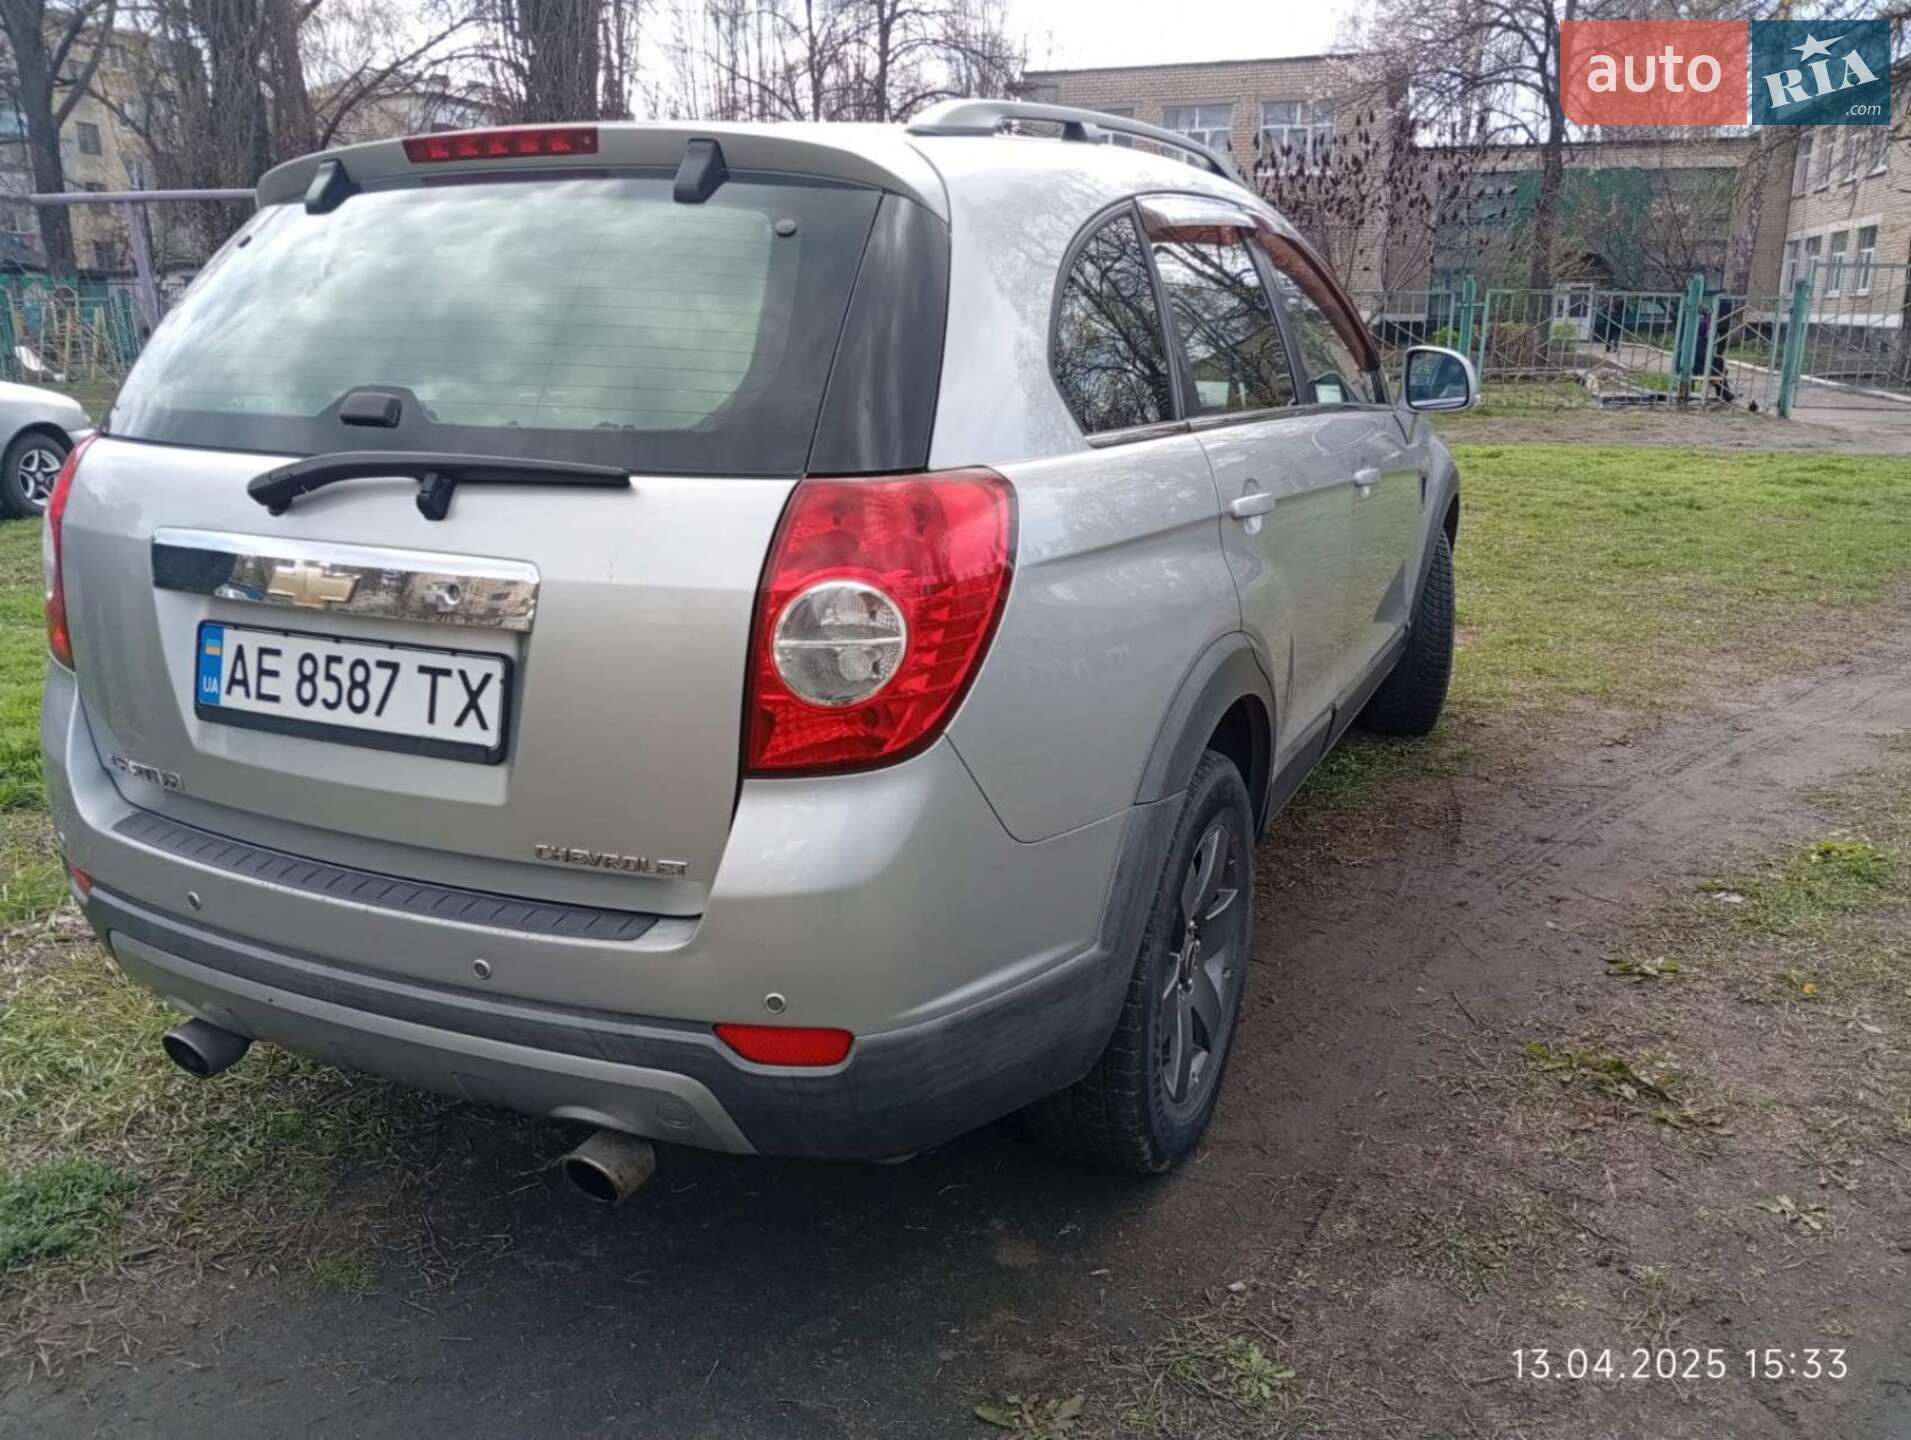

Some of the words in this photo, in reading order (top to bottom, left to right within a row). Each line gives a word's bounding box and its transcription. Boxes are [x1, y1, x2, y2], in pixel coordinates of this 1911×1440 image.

[202, 676, 219, 694] UA
[225, 643, 282, 703] AE
[295, 652, 400, 717] 8587
[417, 664, 493, 731] TX
[535, 844, 689, 876] CHEVROLET
